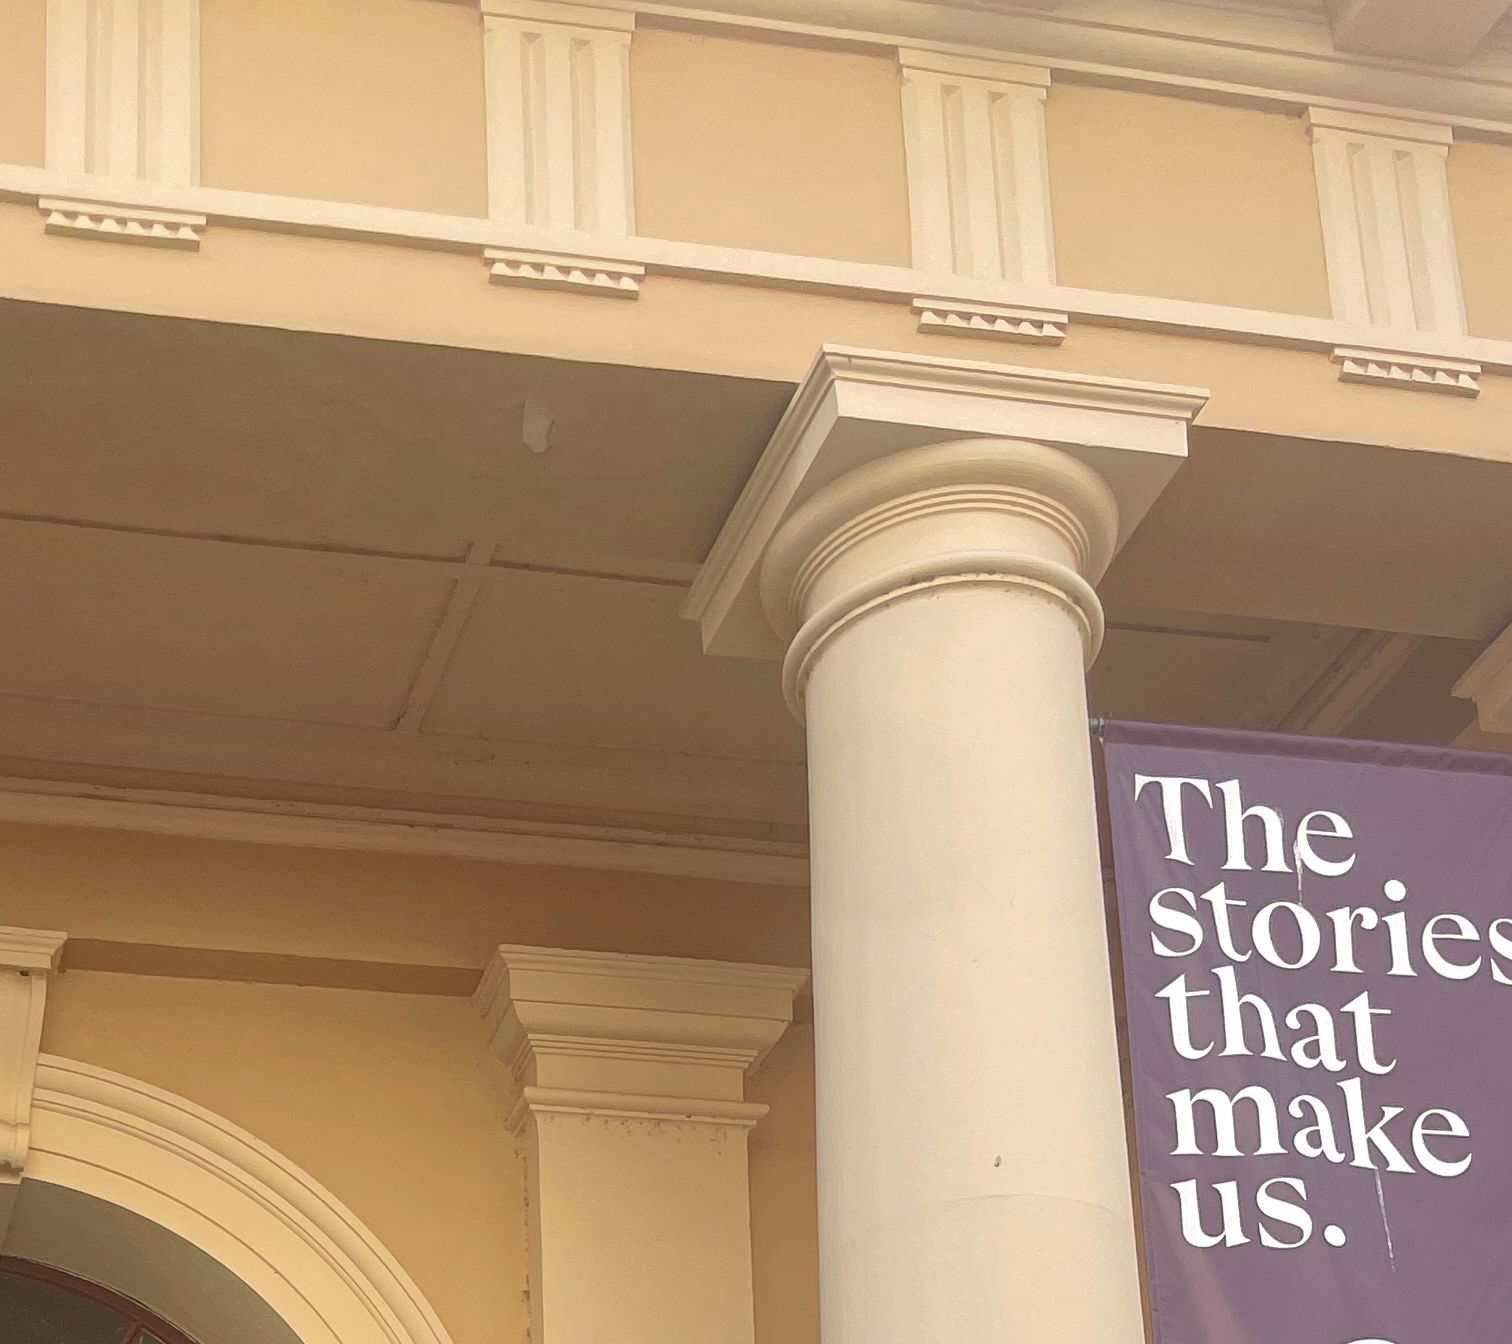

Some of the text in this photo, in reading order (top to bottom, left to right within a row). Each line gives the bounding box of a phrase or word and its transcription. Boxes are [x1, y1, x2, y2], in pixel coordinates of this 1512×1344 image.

[1134, 773, 1356, 877] The
[1154, 965, 1397, 1075] that
[1165, 1076, 1473, 1177] make
[1169, 1177, 1347, 1249] us.
